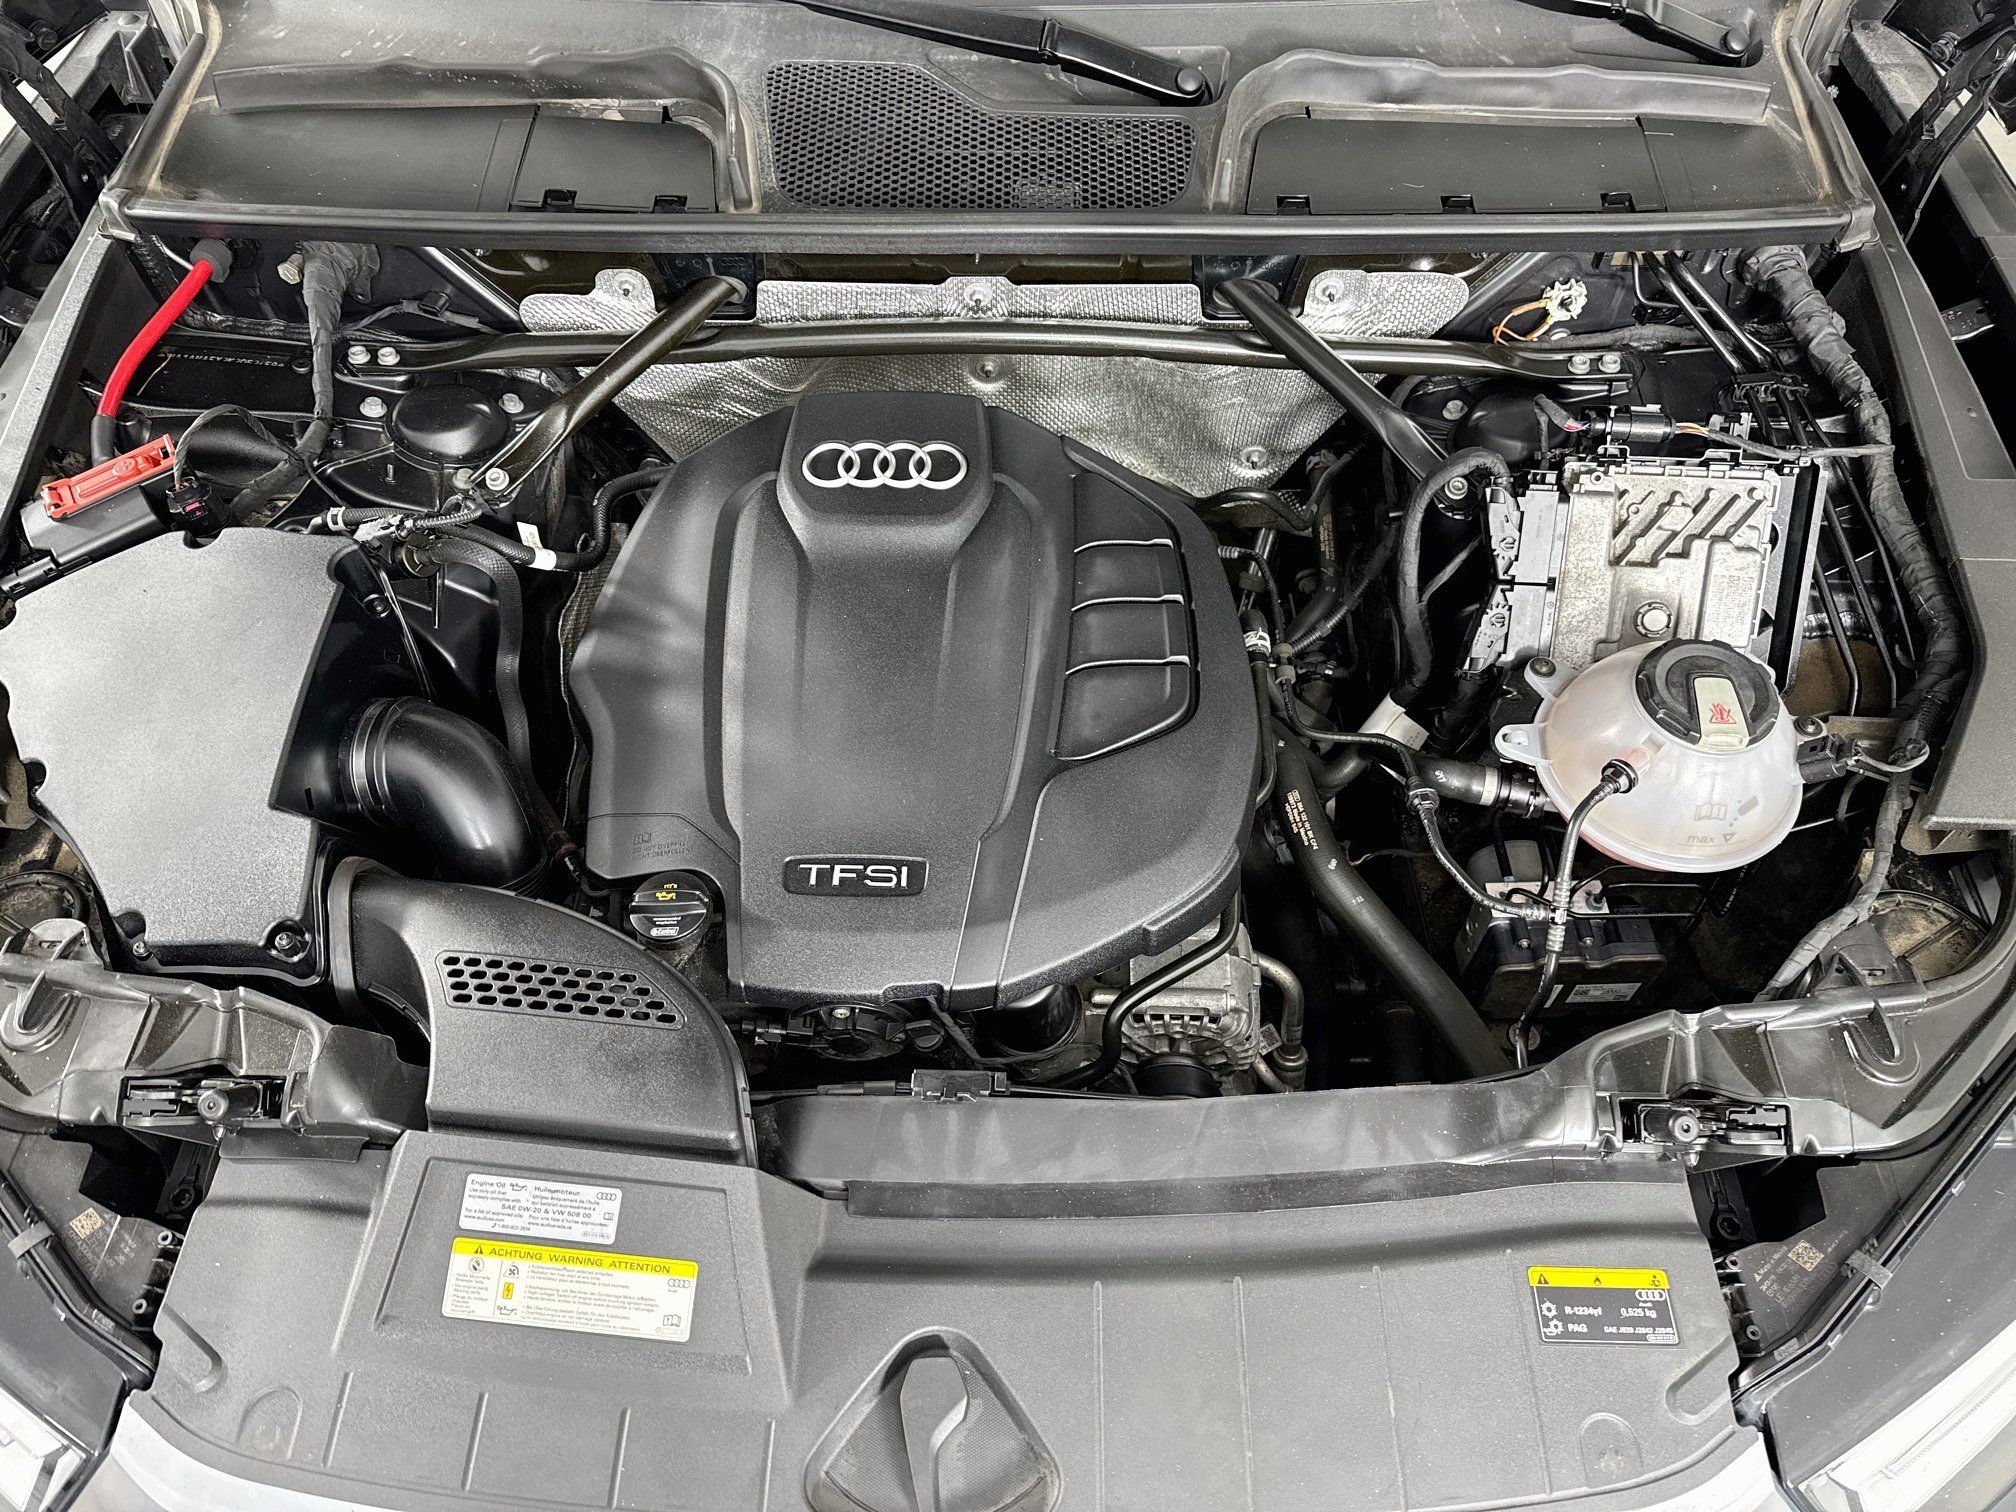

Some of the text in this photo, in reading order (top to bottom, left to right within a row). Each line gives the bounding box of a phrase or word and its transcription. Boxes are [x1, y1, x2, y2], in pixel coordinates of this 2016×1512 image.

[1687, 835, 1715, 844] max
[798, 864, 909, 888] TFSI
[470, 1179, 495, 1188] Engine
[501, 1203, 516, 1211] SAE
[517, 1205, 542, 1214] 0W-20
[489, 1248, 670, 1274] ACHTUNG WARNING ATTENTION
[1563, 1306, 1604, 1317] R-1234yf
[1644, 1308, 1658, 1319] kg
[1567, 1323, 1589, 1333] PAG
